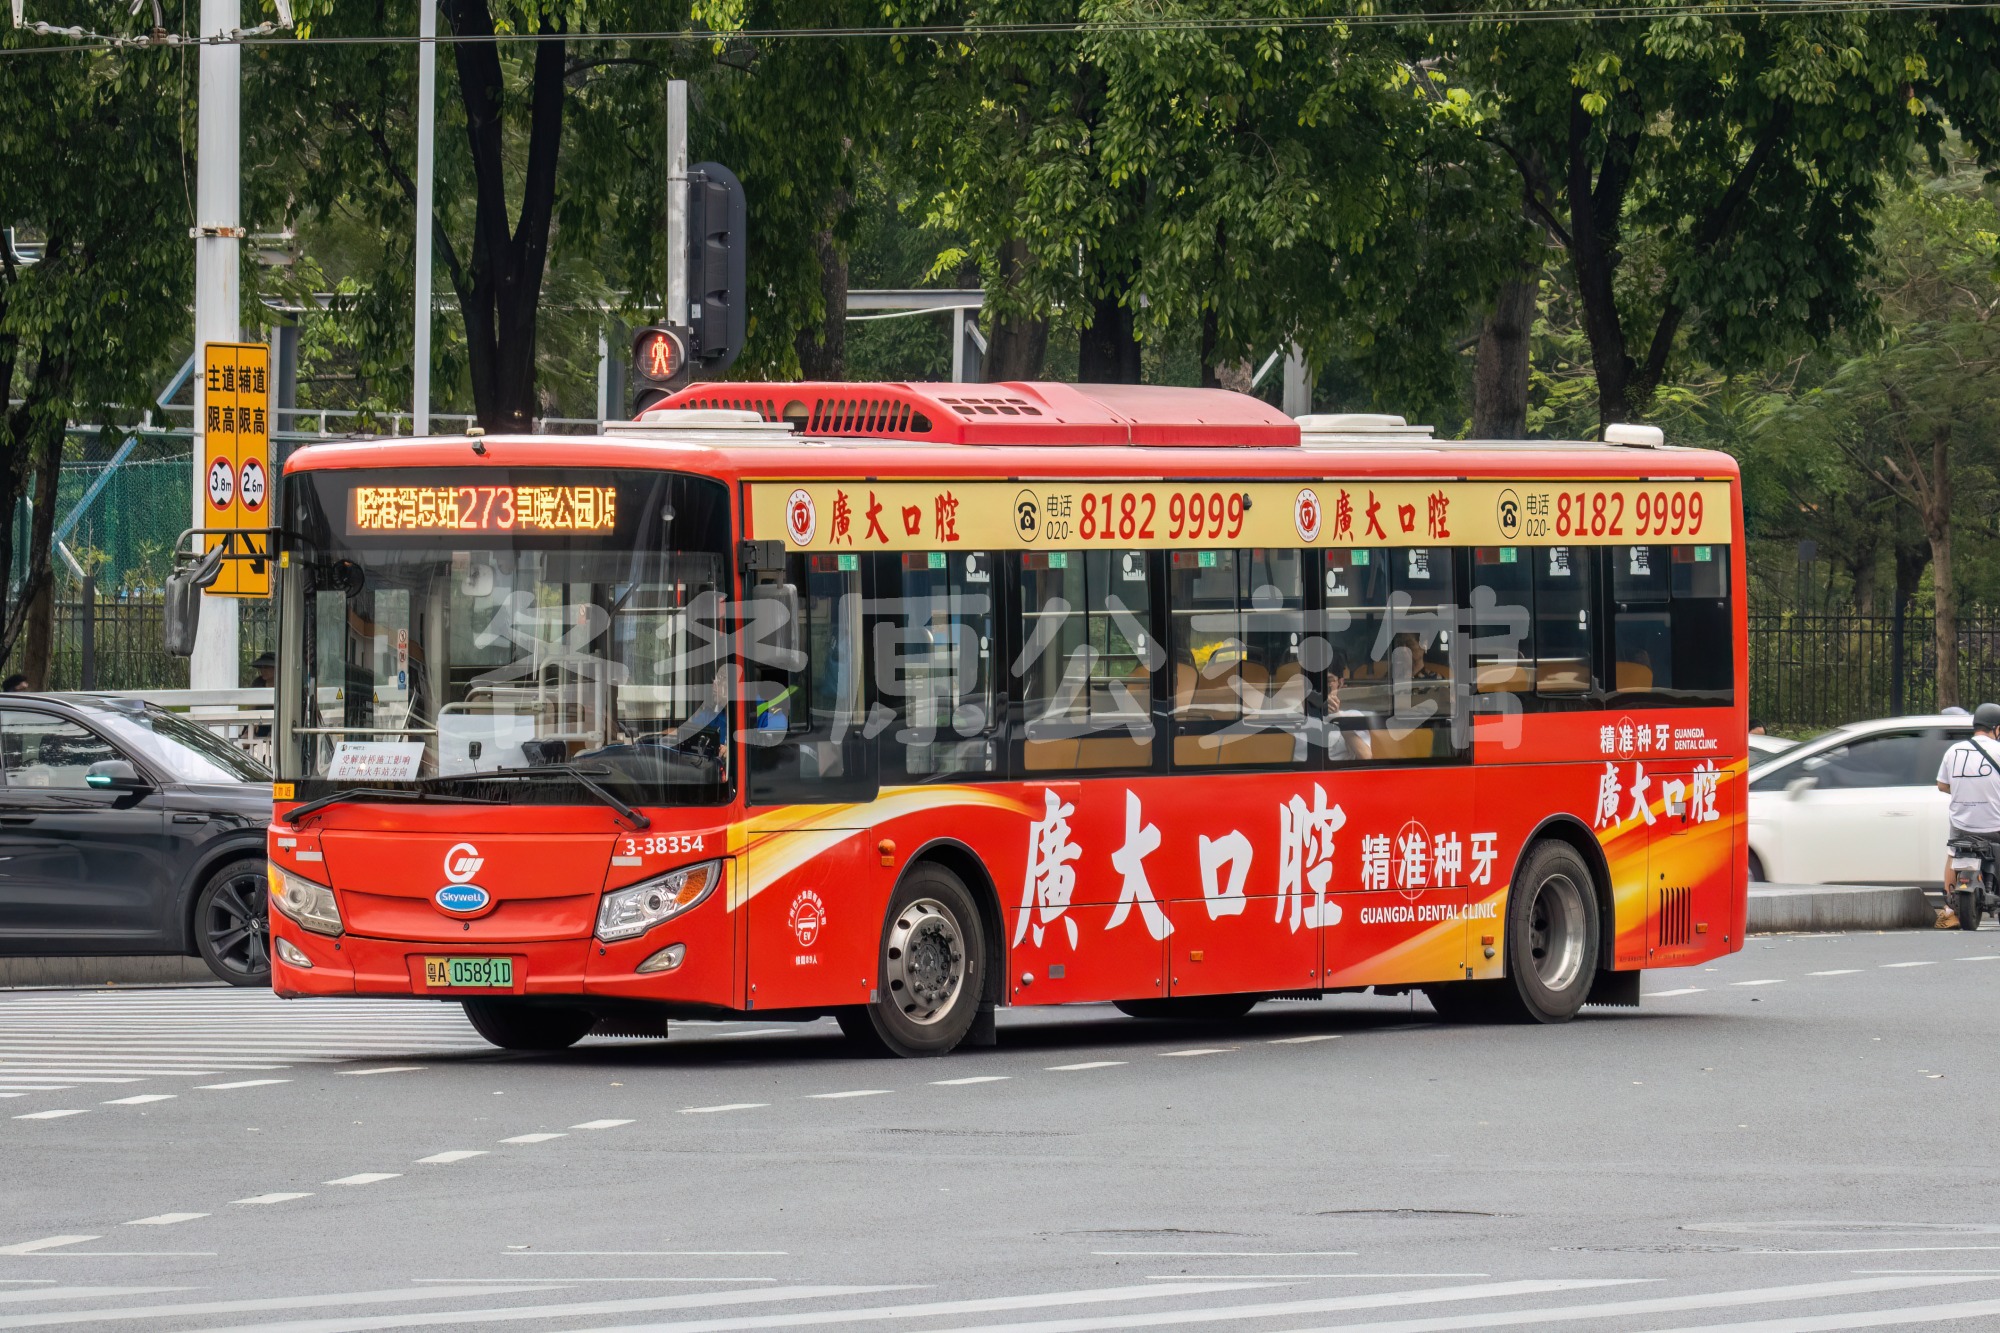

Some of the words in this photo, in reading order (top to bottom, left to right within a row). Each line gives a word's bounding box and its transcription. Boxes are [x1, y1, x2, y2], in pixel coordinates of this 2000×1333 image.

[207, 364, 235, 393] 主道
[239, 366, 265, 394] 辅道
[208, 405, 235, 434] 限高
[239, 406, 265, 435] 限高
[211, 471, 232, 492] 3.8m
[243, 472, 263, 493] 2.6m
[459, 487, 515, 529] 273
[829, 489, 960, 546] 廣大口腔
[1046, 494, 1072, 518] 电话
[1079, 493, 1156, 540] 8182
[1169, 492, 1244, 539] 9999
[1333, 489, 1451, 542] 廣大口腔
[1526, 493, 1550, 516] 电话
[1556, 492, 1624, 537] 8182
[1636, 491, 1703, 536] 9999
[1046, 521, 1073, 540] 020-
[1526, 519, 1551, 537] 020-
[1600, 724, 1670, 753] 精准种牙
[1674, 728, 1704, 738] GUANGDA
[1674, 740, 1697, 750] DENTAL
[1698, 739, 1718, 749] CLINIC
[1594, 758, 1721, 829] 廣大口腔
[625, 836, 704, 856] 3-38354
[1012, 782, 1346, 951] 廣大口腔
[1361, 831, 1498, 890] 精准种牙
[441, 892, 482, 902] Skywell
[1360, 906, 1415, 924] GUANGDA
[1418, 904, 1459, 922] DENTAL
[1462, 902, 1497, 919] CLINIC
[803, 931, 811, 941] EV
[454, 962, 511, 983] 05891D
